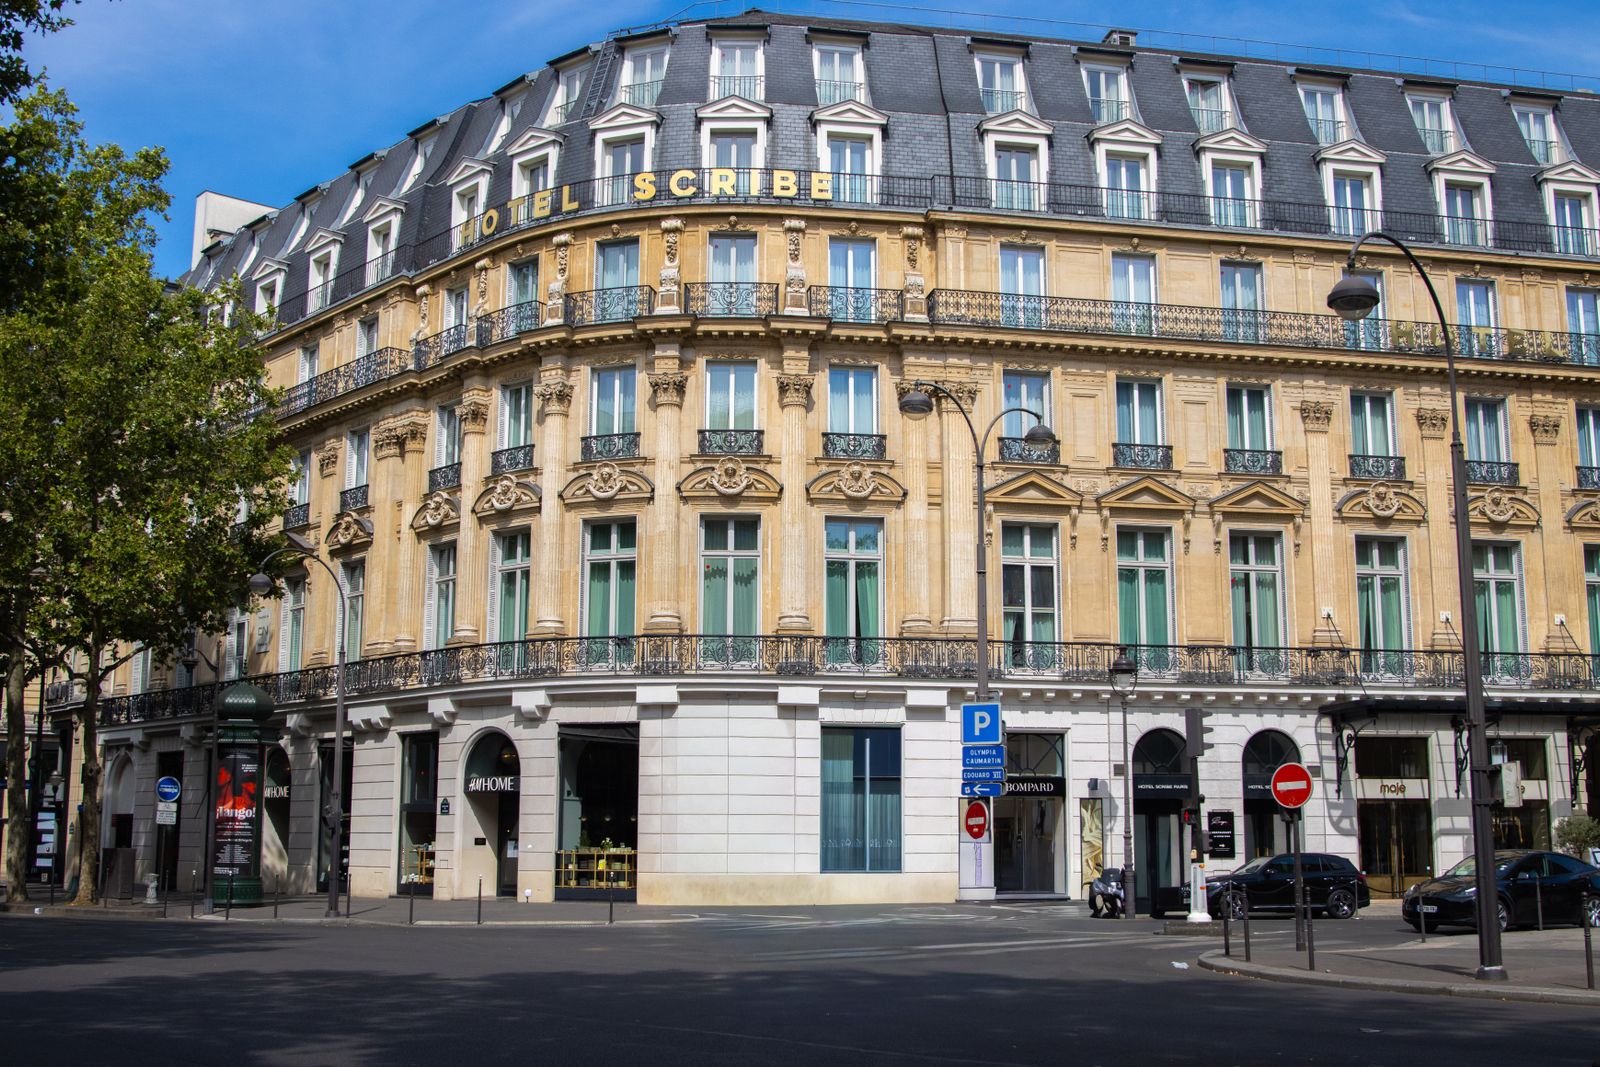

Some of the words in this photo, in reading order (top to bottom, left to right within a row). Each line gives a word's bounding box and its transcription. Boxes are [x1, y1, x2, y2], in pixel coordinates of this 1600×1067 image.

[460, 185, 579, 246] HOTEL
[633, 168, 833, 200] SCRIBE
[974, 711, 991, 736] P
[992, 771, 1002, 779] VII
[482, 776, 514, 791] HOME
[1006, 782, 1054, 792] BOMPARD
[1379, 782, 1406, 796] maje
